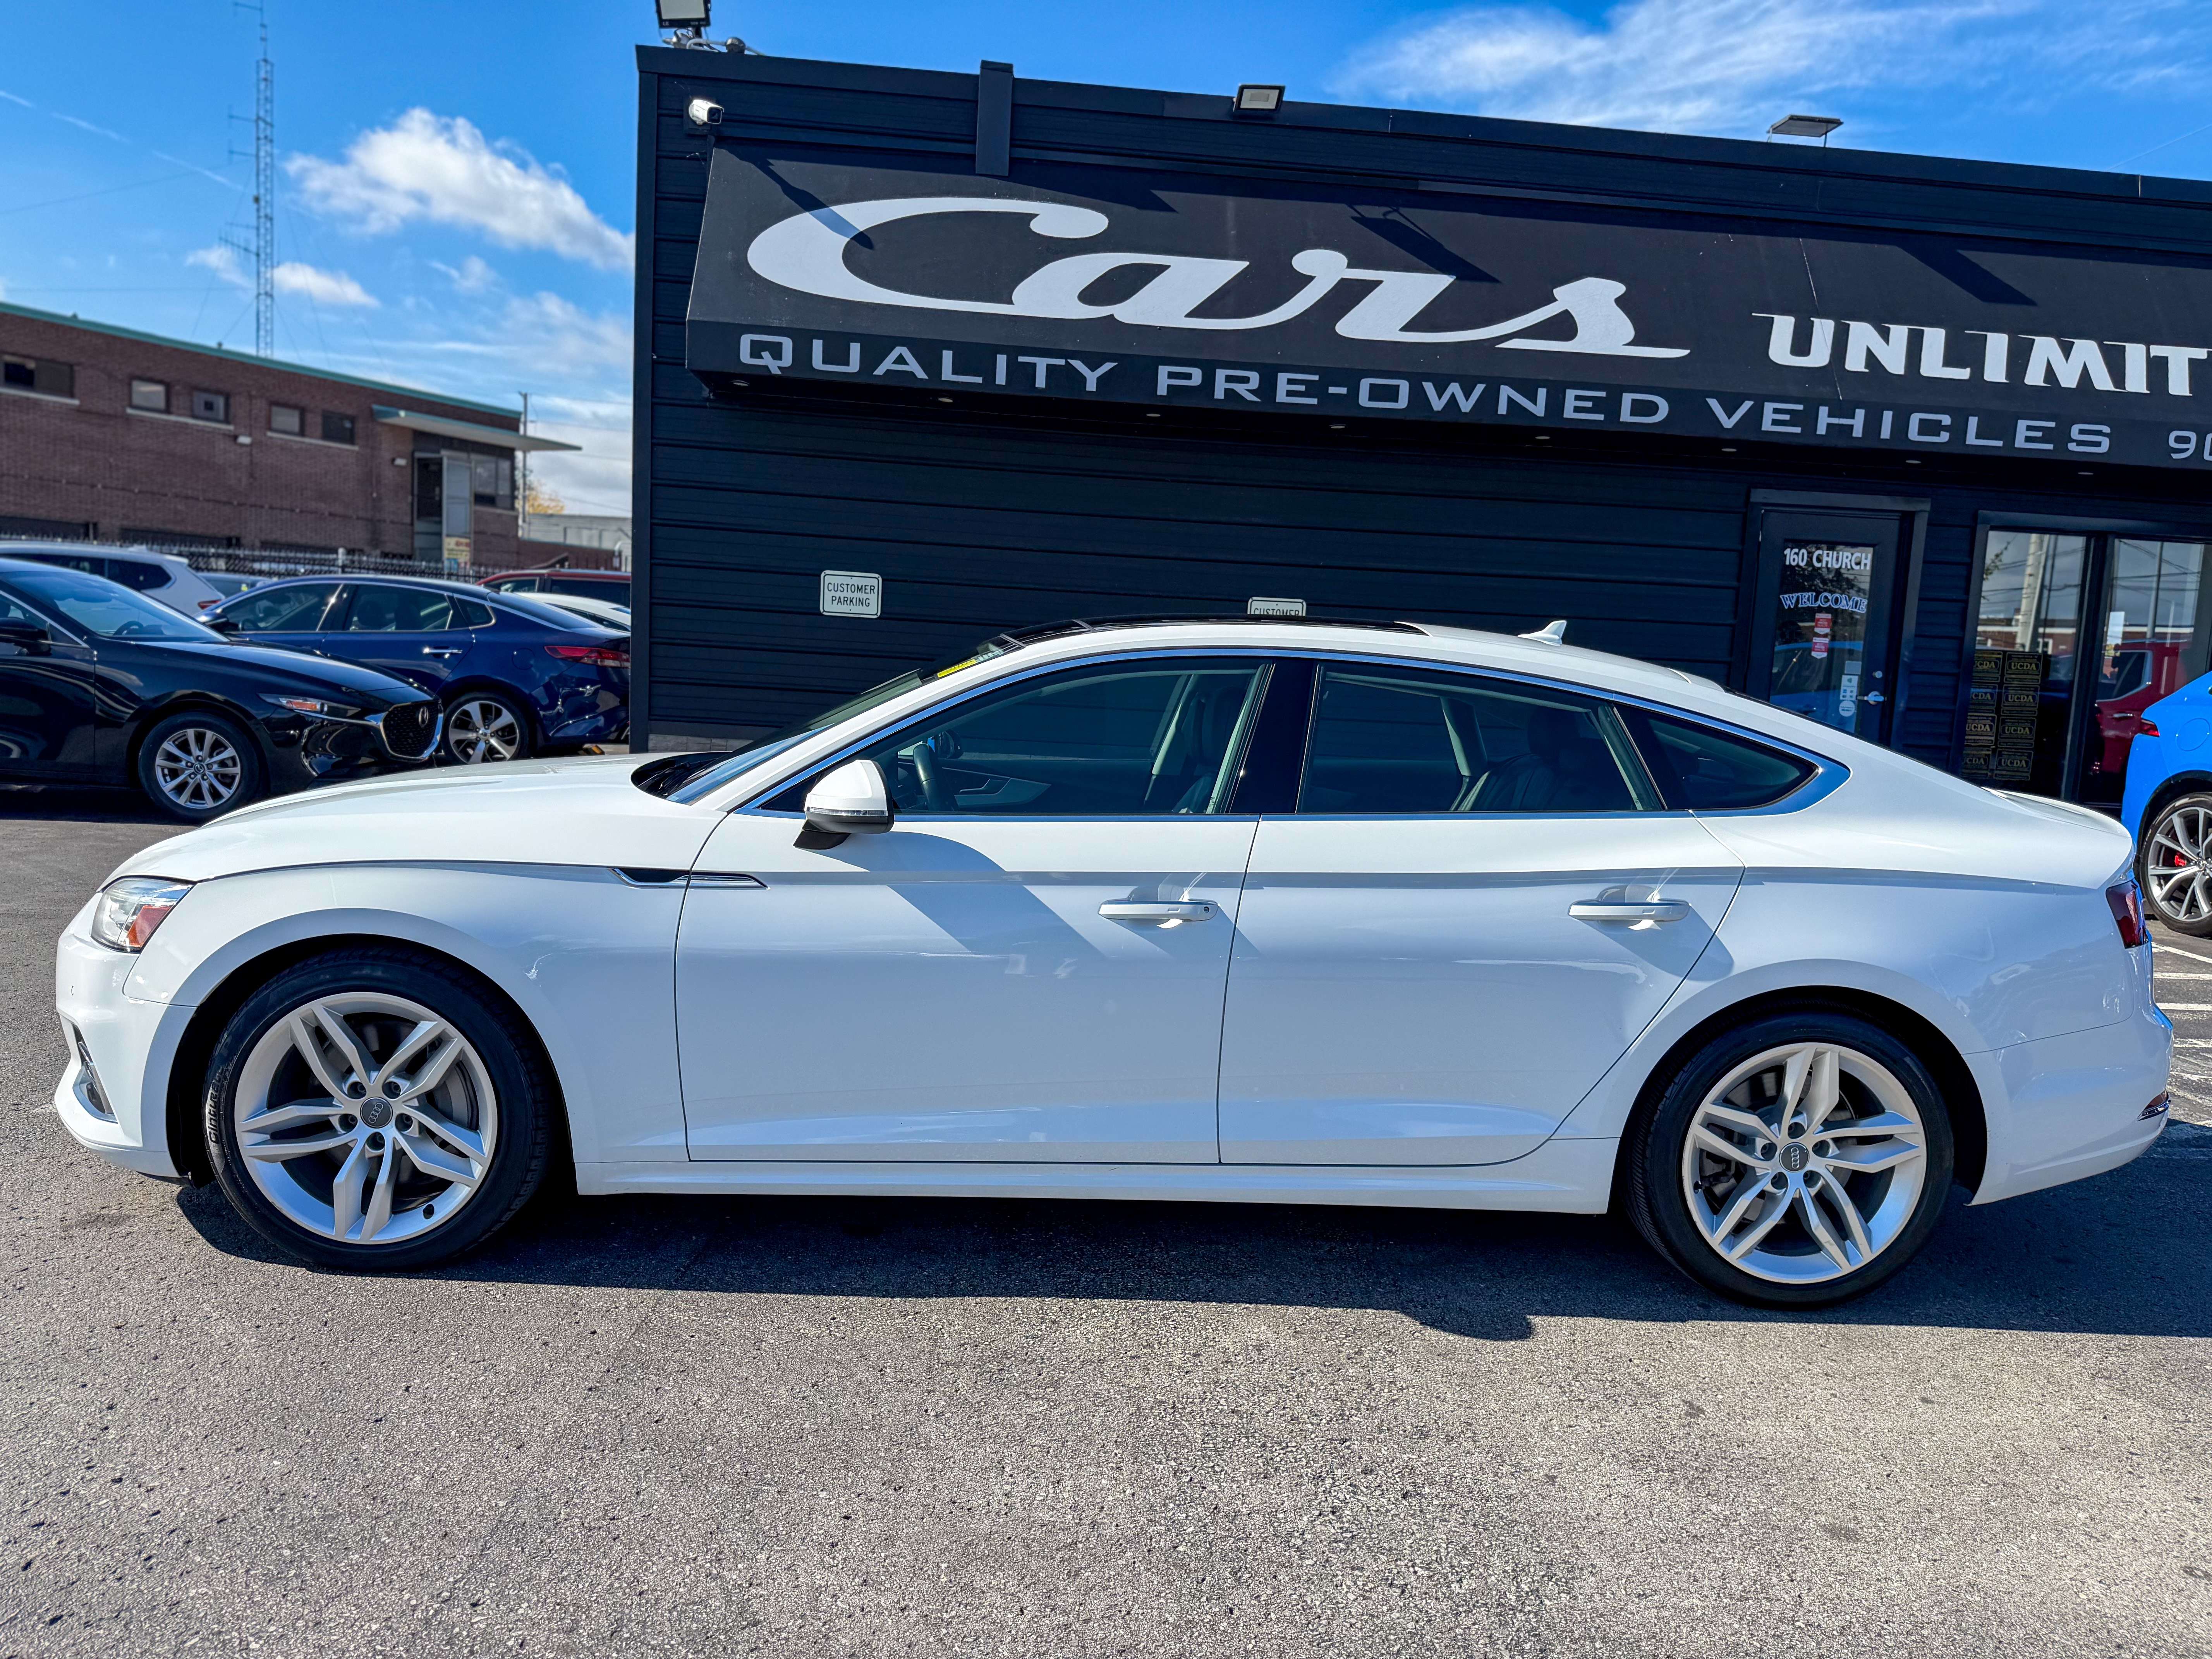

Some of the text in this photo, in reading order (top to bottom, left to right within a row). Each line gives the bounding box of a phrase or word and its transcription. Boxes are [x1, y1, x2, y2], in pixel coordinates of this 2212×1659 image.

[747, 197, 2212, 397] Cars UNLIMIT
[740, 334, 1118, 392] QUALITY
[1157, 365, 1669, 424] PRE-OWNED
[1705, 398, 2111, 454] VEHICLES
[1784, 548, 1871, 570] 160 CHURCH
[827, 582, 876, 594] CUSTOMER
[831, 596, 870, 607] PARKING
[1780, 592, 1868, 613] WELCOME
[2011, 662, 2037, 670] UCDA
[1972, 692, 1991, 700] CDA
[2008, 694, 2033, 702] UCDA
[1966, 723, 1990, 732] UCDA
[2005, 726, 2030, 735] UCDA
[2001, 759, 2027, 768] UCDA
